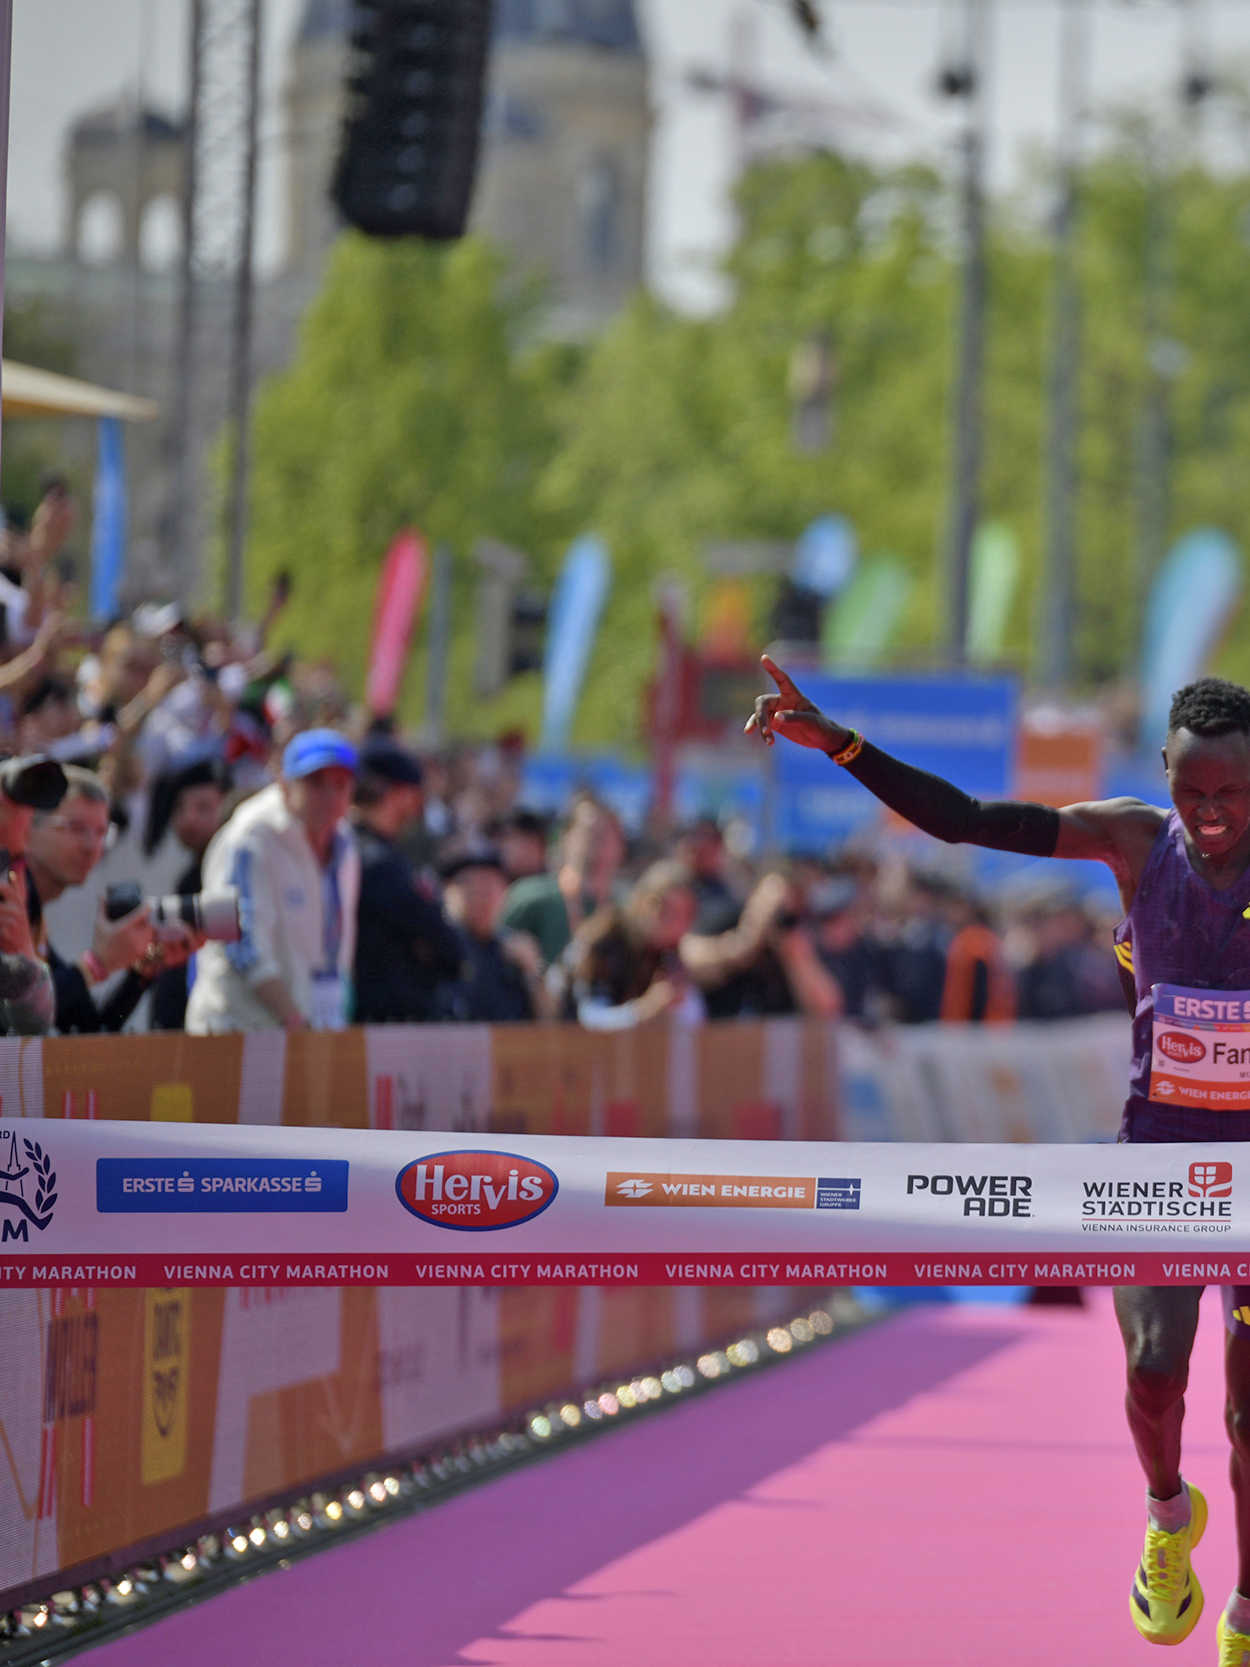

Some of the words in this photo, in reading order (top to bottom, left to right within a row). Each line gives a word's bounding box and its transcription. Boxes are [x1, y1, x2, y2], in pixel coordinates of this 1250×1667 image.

[1173, 996, 1240, 1020] ERSTE
[1161, 1036, 1202, 1058] Hervis
[1179, 1086, 1207, 1099] WIEN
[123, 1177, 175, 1193] ERSTE
[201, 1177, 302, 1193] SPARKASSE
[415, 1164, 544, 1210] Hervis
[661, 1183, 716, 1197] WIEN
[721, 1184, 806, 1198] ENERGIE
[906, 1175, 1033, 1196] POWER
[1083, 1182, 1184, 1198] WIENER
[431, 1203, 481, 1215] SPORTS
[963, 1197, 1032, 1217] ADE
[1082, 1200, 1232, 1217] STÄDTISCHE
[1081, 1223, 1124, 1233] VIENNA
[1126, 1224, 1191, 1233] INSURANCE
[1193, 1225, 1232, 1233] GROUP
[32, 1265, 136, 1280] MARATHON
[163, 1265, 234, 1279] VIENNA
[239, 1264, 281, 1279] CITY
[286, 1264, 389, 1279] MARATHON
[415, 1264, 485, 1279] VIENNA
[490, 1264, 531, 1278] CITY
[536, 1264, 639, 1278] MARATHON
[665, 1264, 735, 1278] VIENNA
[739, 1264, 780, 1278] CITY
[785, 1264, 887, 1279] MARATHON
[913, 1264, 983, 1278] VIENNA
[988, 1263, 1029, 1278] CITY
[1034, 1263, 1136, 1278] MARATHON
[1162, 1263, 1232, 1278] VIENNA
